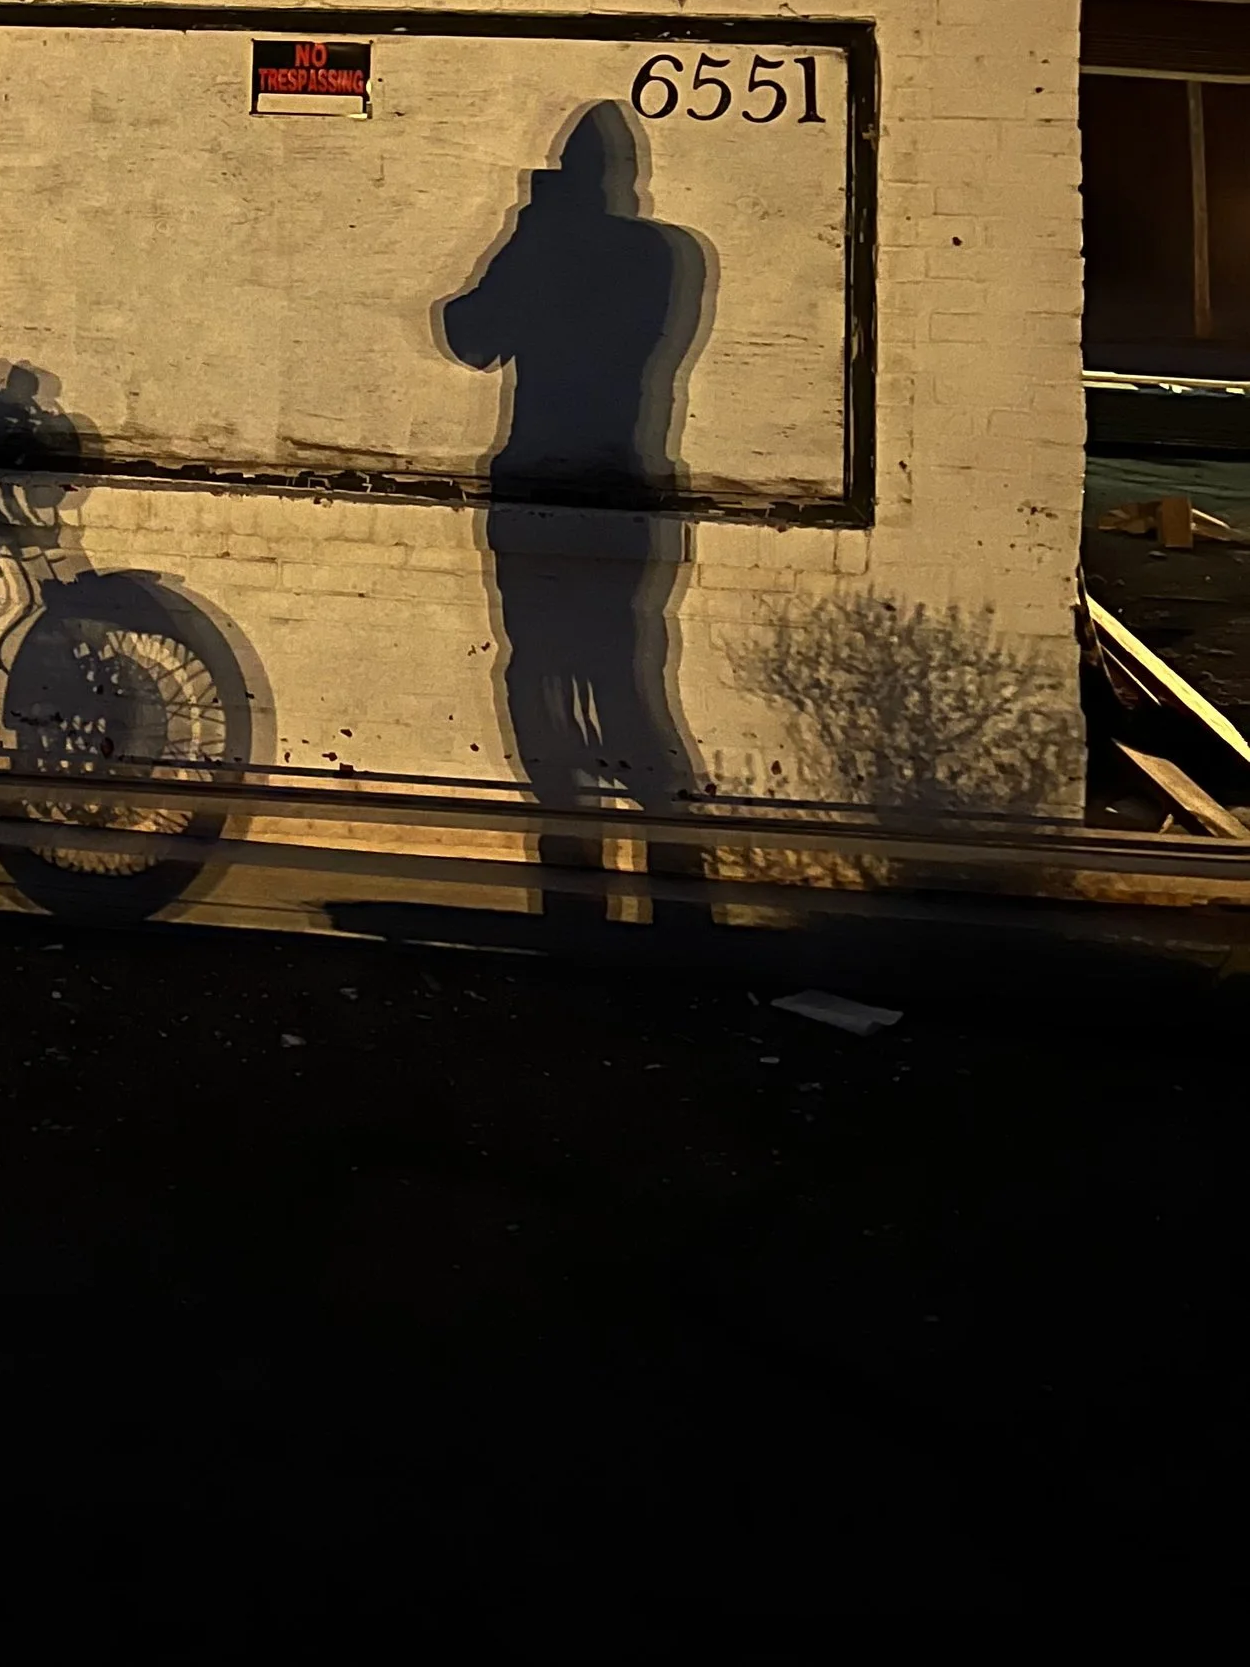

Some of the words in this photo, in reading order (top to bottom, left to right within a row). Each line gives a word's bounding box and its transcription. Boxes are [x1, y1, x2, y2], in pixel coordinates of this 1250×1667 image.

[295, 43, 328, 67] NO
[258, 68, 364, 94] TRESPASSING
[631, 52, 826, 124] 6551
